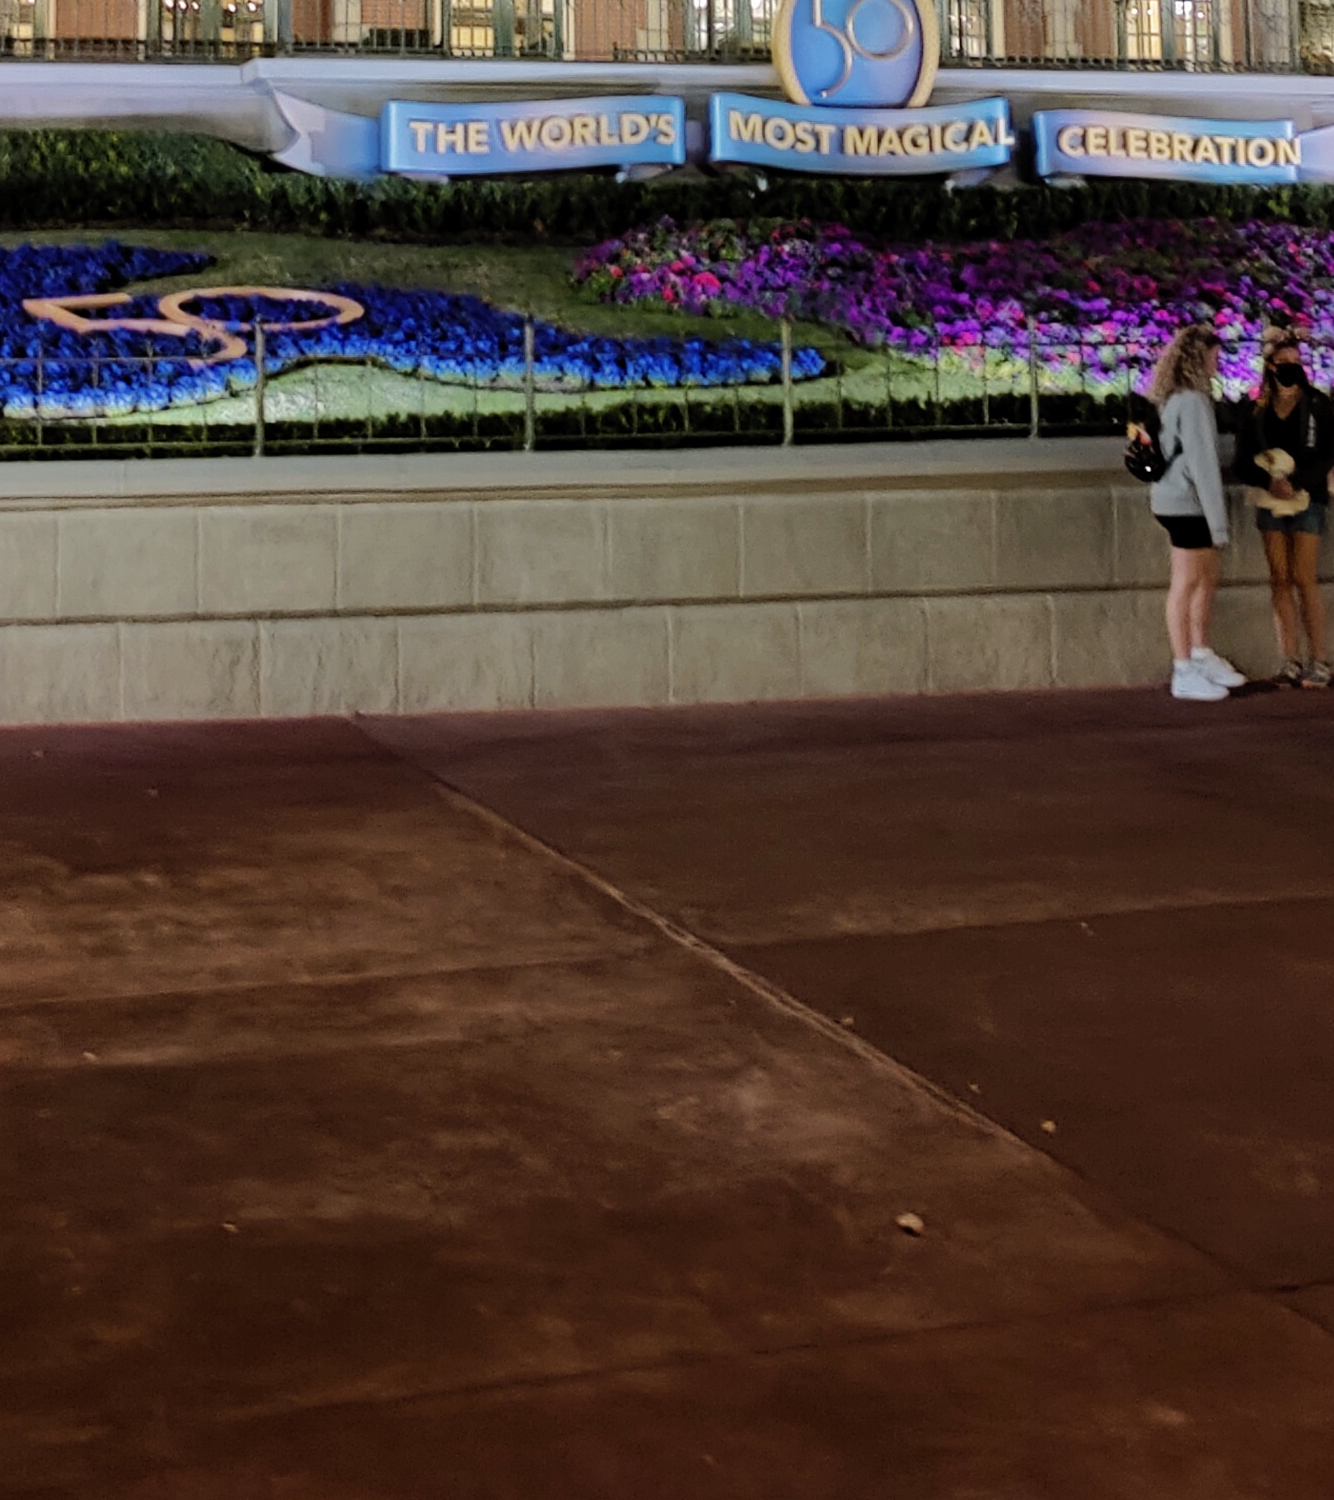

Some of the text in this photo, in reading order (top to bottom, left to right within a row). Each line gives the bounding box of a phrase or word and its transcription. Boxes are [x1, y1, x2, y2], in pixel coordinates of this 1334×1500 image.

[408, 109, 1301, 167] THE WORLD'S MOST MAGICAL CELEBRATION
